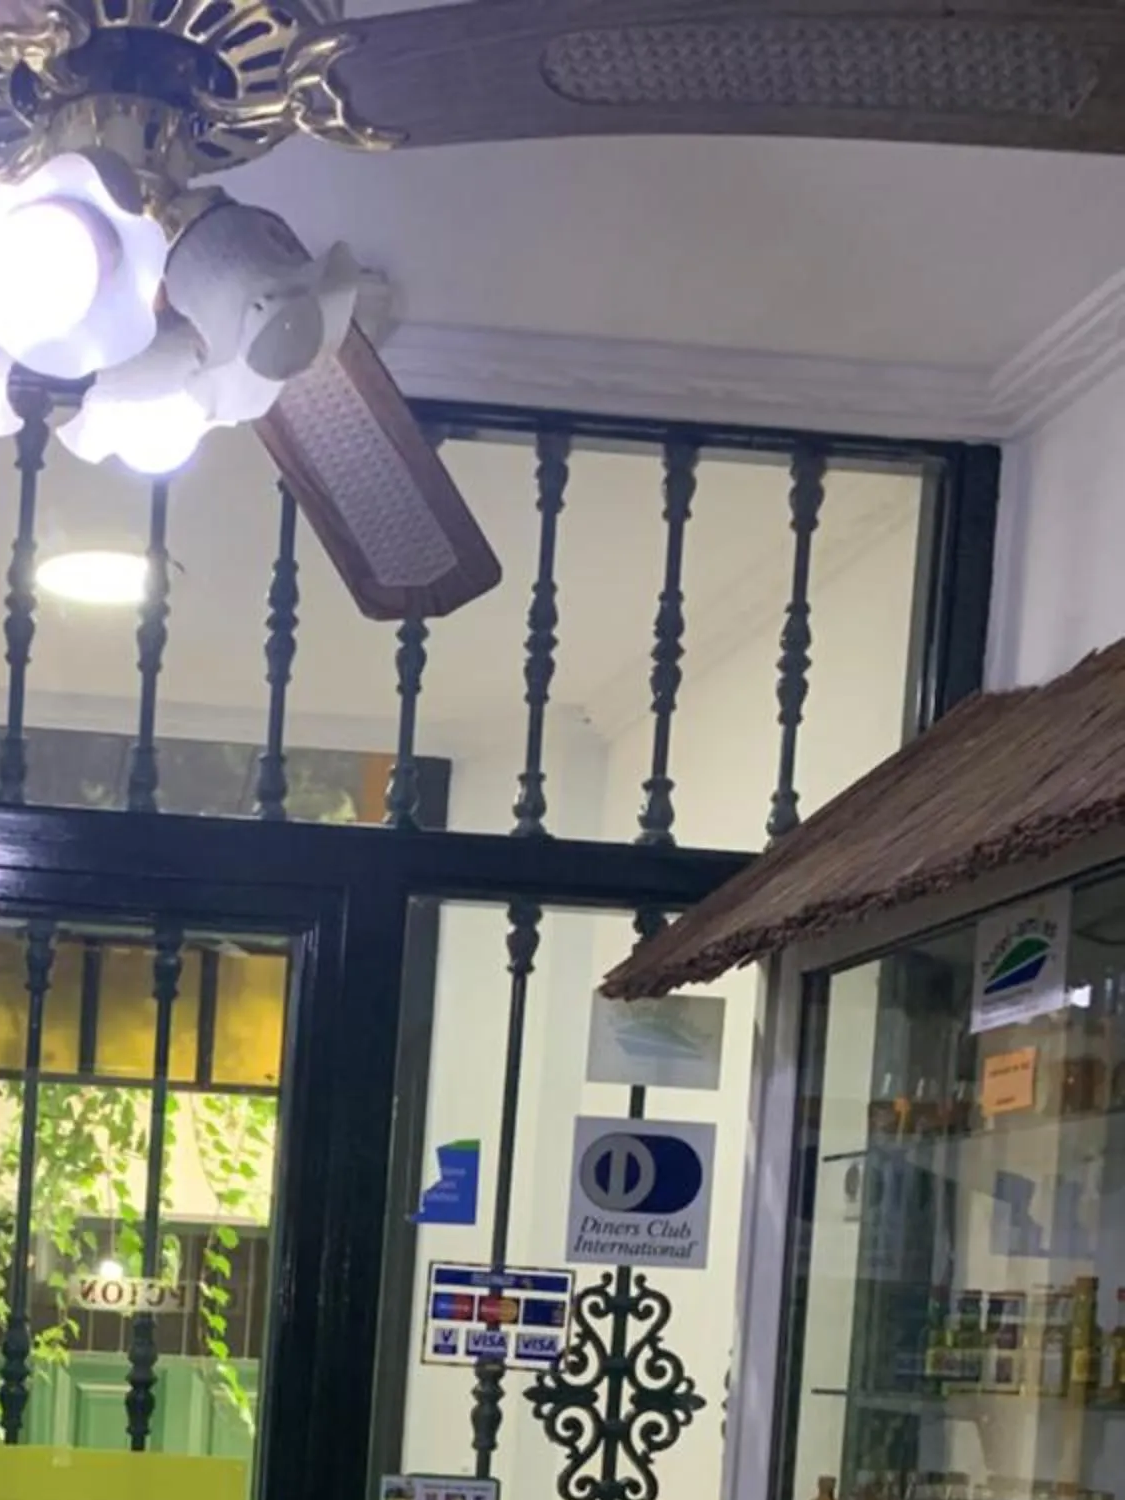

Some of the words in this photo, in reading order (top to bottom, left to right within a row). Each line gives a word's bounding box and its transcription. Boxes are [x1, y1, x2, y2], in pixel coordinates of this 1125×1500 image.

[581, 1216, 640, 1237] Diners
[647, 1219, 692, 1239] Club
[573, 1234, 698, 1259] International
[472, 1334, 507, 1347] VISA
